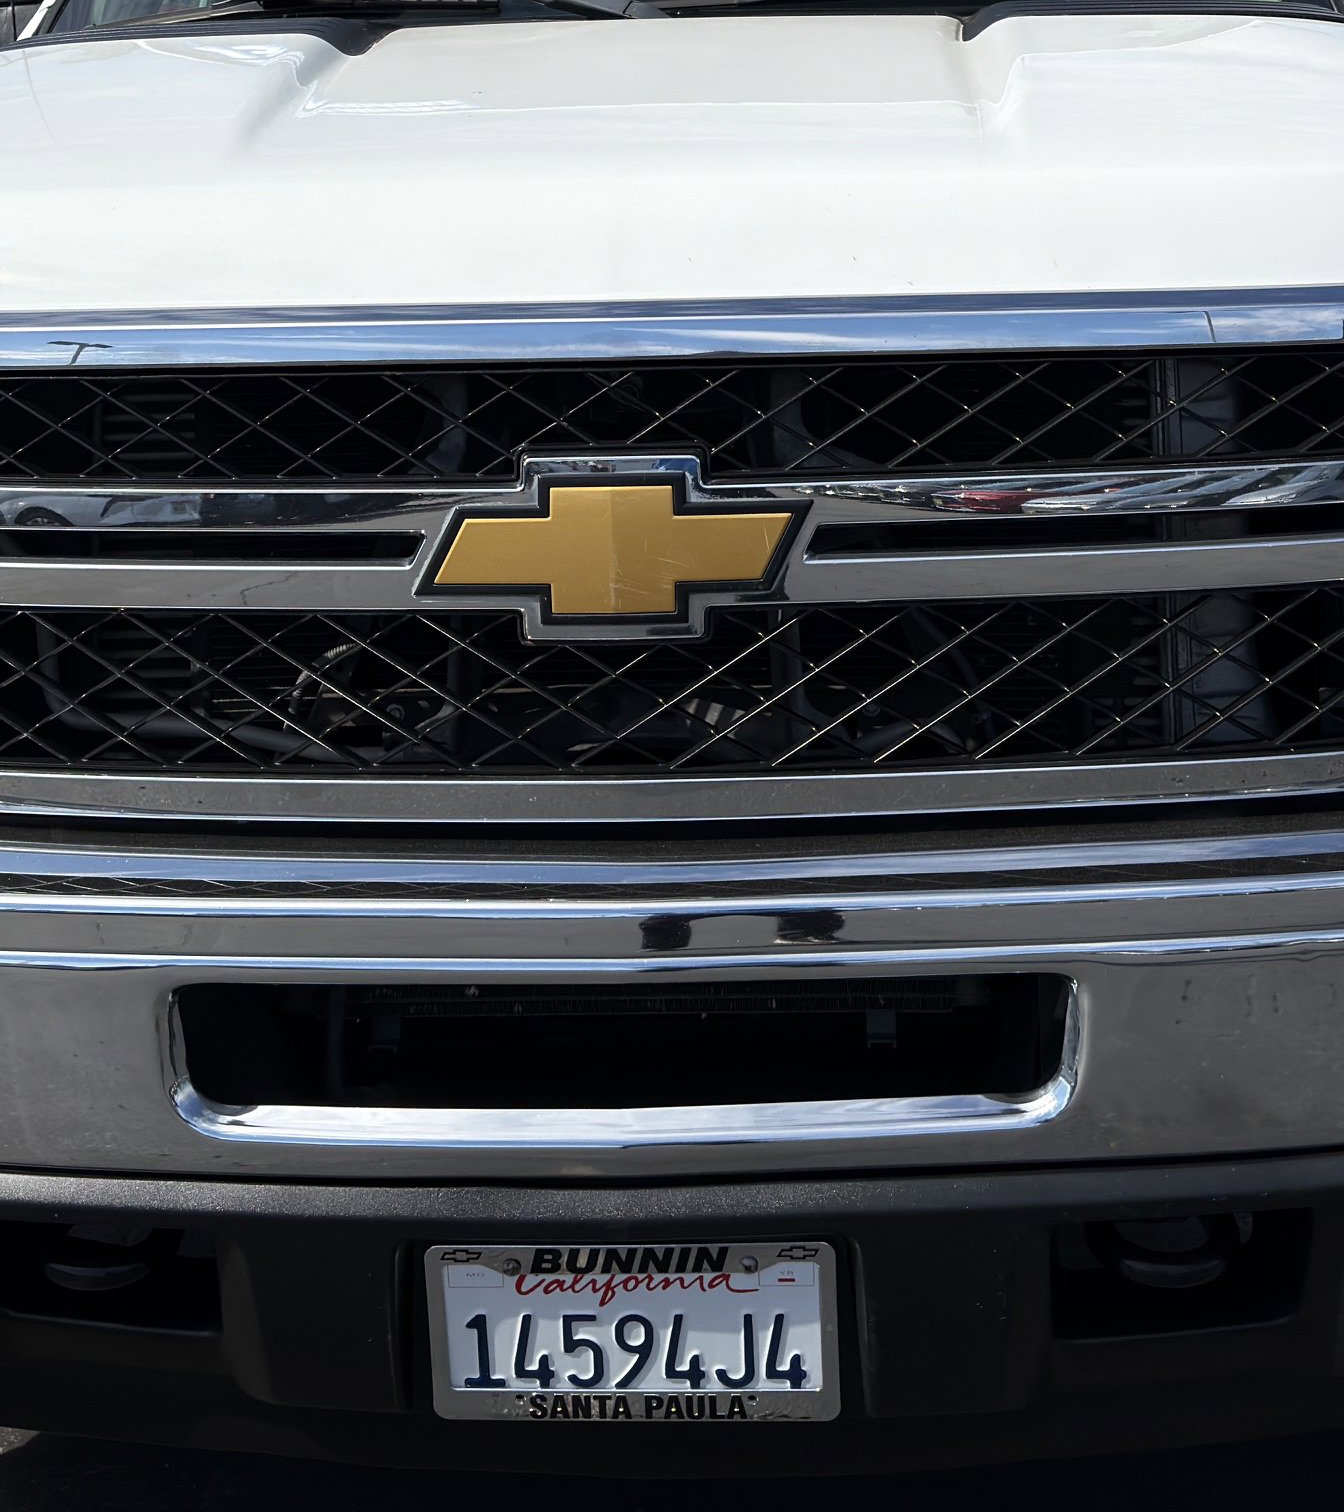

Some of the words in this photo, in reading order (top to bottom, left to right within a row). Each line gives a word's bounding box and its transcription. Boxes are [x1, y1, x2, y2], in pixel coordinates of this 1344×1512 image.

[530, 1246, 729, 1274] BUNNIN
[515, 1273, 760, 1307] California
[464, 1313, 807, 1389] 14594J4
[528, 1393, 633, 1420] SANTA
[645, 1393, 747, 1420] PAULA
